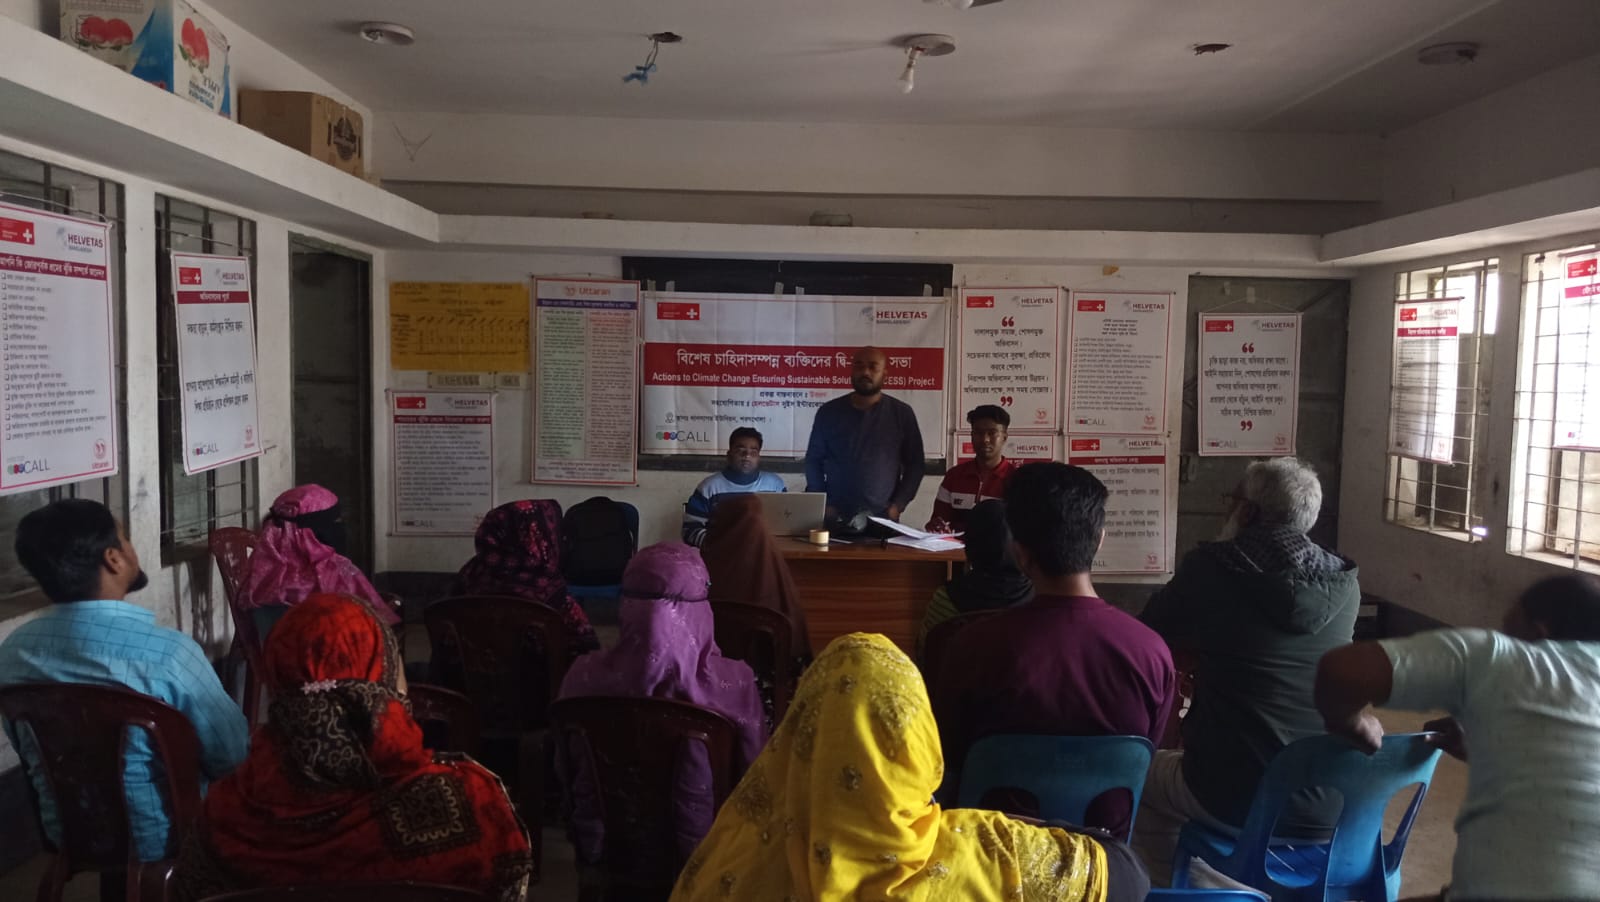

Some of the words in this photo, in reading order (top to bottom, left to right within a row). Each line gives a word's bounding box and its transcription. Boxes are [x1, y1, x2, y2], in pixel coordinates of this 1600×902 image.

[67, 233, 103, 248] HELVETAS
[876, 310, 928, 320] HELVETAS
[676, 348, 712, 366] বিশেষ
[714, 349, 780, 369] চাহিদাসম্পন্ন
[784, 351, 832, 368] ব্যক্তিদের
[889, 356, 912, 369] সভা
[652, 372, 681, 382] Actions
[683, 373, 690, 382] to
[692, 372, 720, 383] Climate
[722, 373, 750, 385] Change
[752, 374, 786, 385] Ensuring
[788, 375, 830, 384] Sustainable
[832, 376, 852, 384] Solut
[908, 377, 935, 388] Project
[676, 430, 712, 442] CALL
[24, 458, 50, 474] CALL
